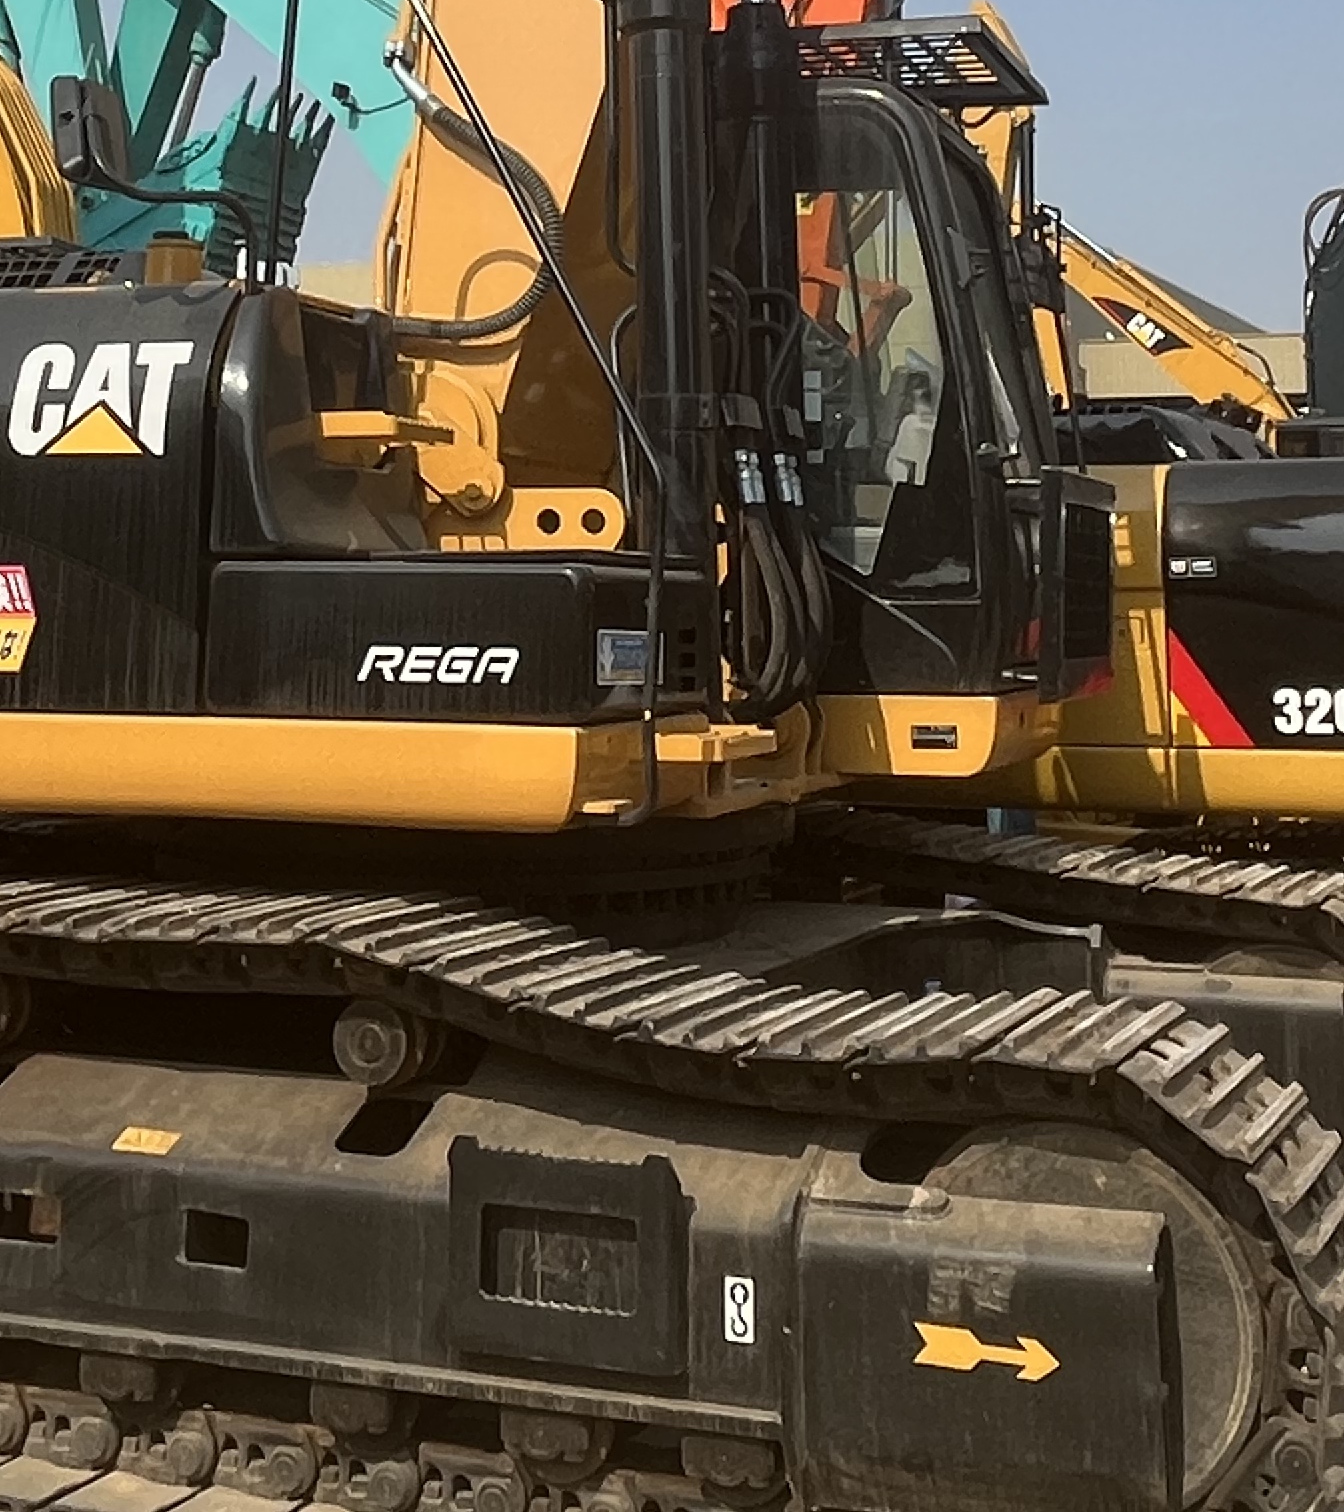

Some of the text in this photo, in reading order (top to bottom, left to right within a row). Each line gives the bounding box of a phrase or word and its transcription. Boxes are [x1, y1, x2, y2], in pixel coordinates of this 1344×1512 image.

[1126, 312, 1166, 349] CAT
[8, 341, 194, 457] CAT
[357, 644, 520, 685] REGA
